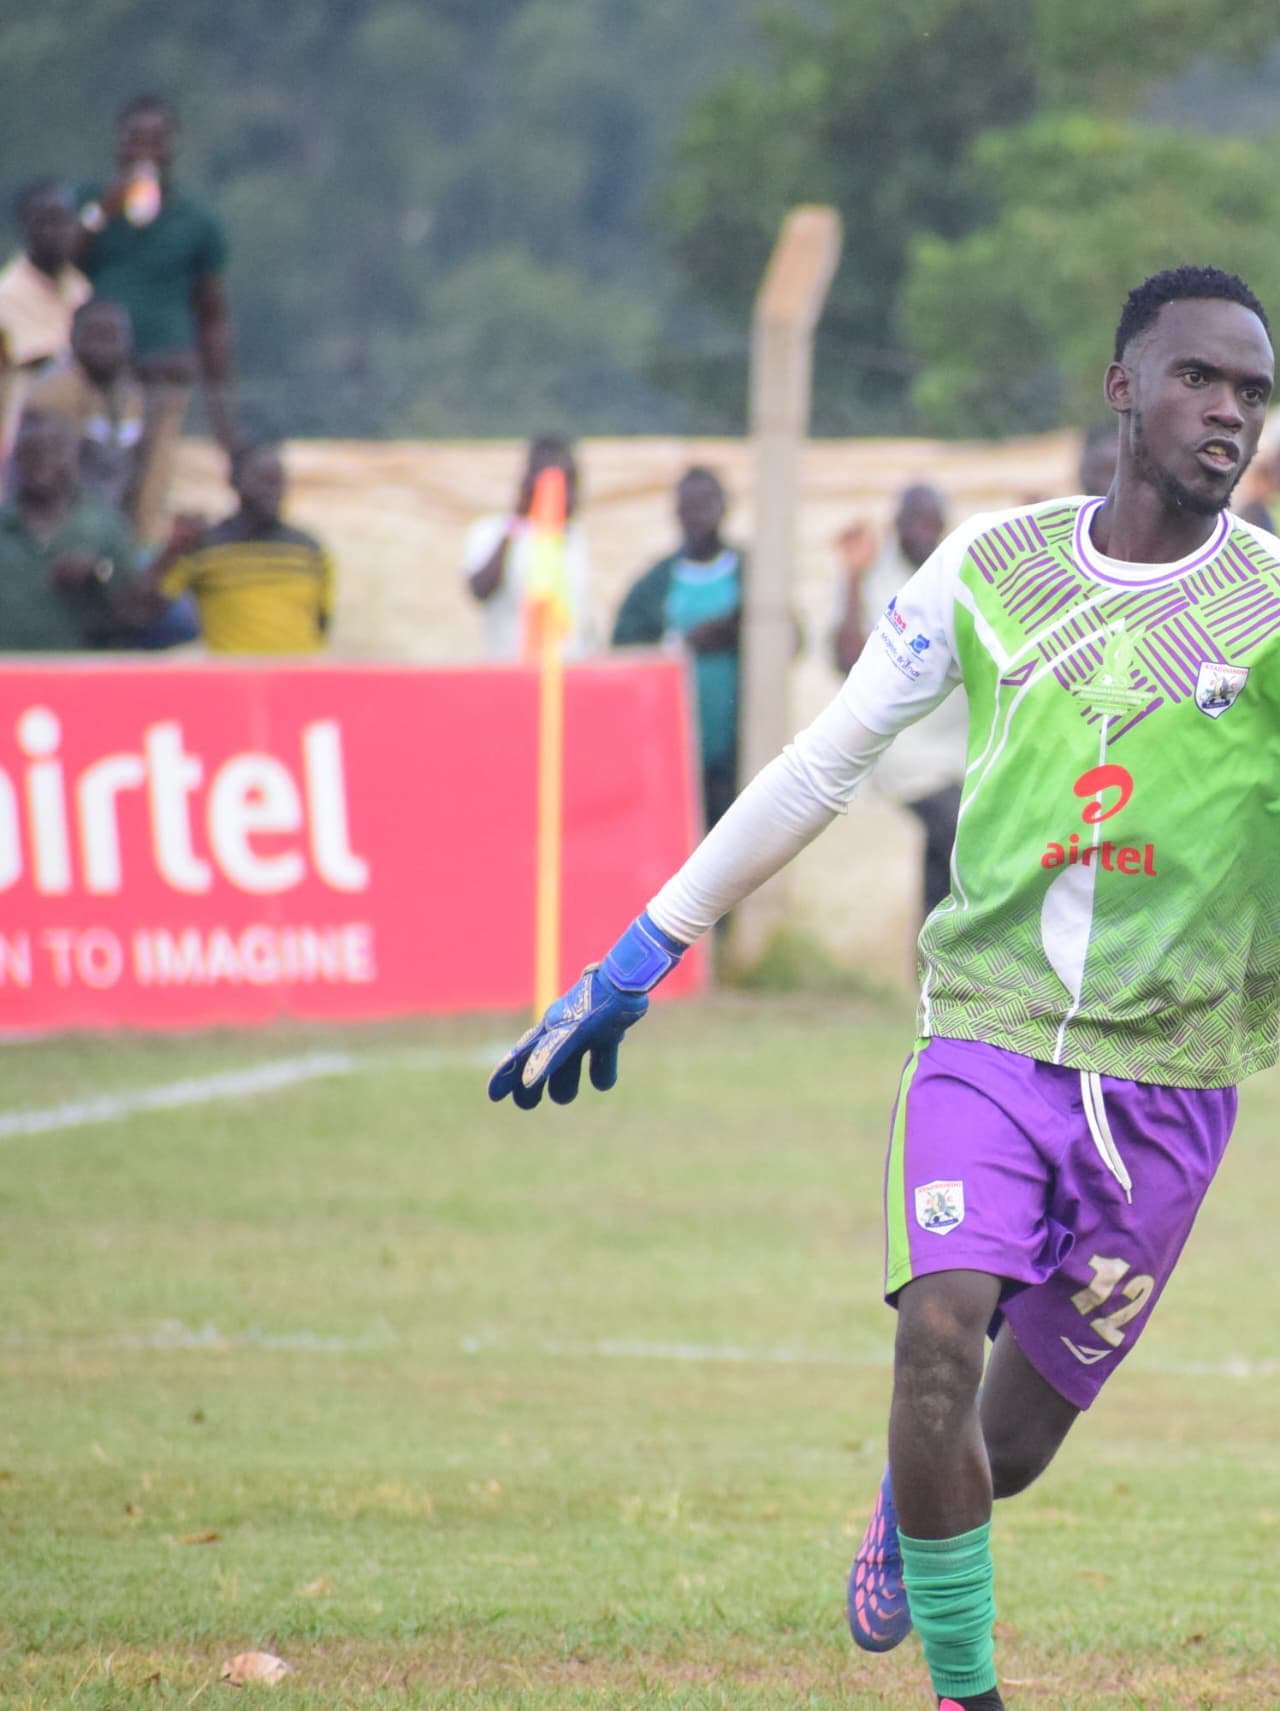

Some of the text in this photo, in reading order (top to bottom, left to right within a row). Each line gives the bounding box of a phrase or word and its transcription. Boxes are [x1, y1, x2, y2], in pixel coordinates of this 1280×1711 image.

[1041, 833, 1157, 876] airtel
[44, 927, 123, 989] TO
[132, 922, 374, 986] IMAGINE
[1070, 1254, 1155, 1347] 12
